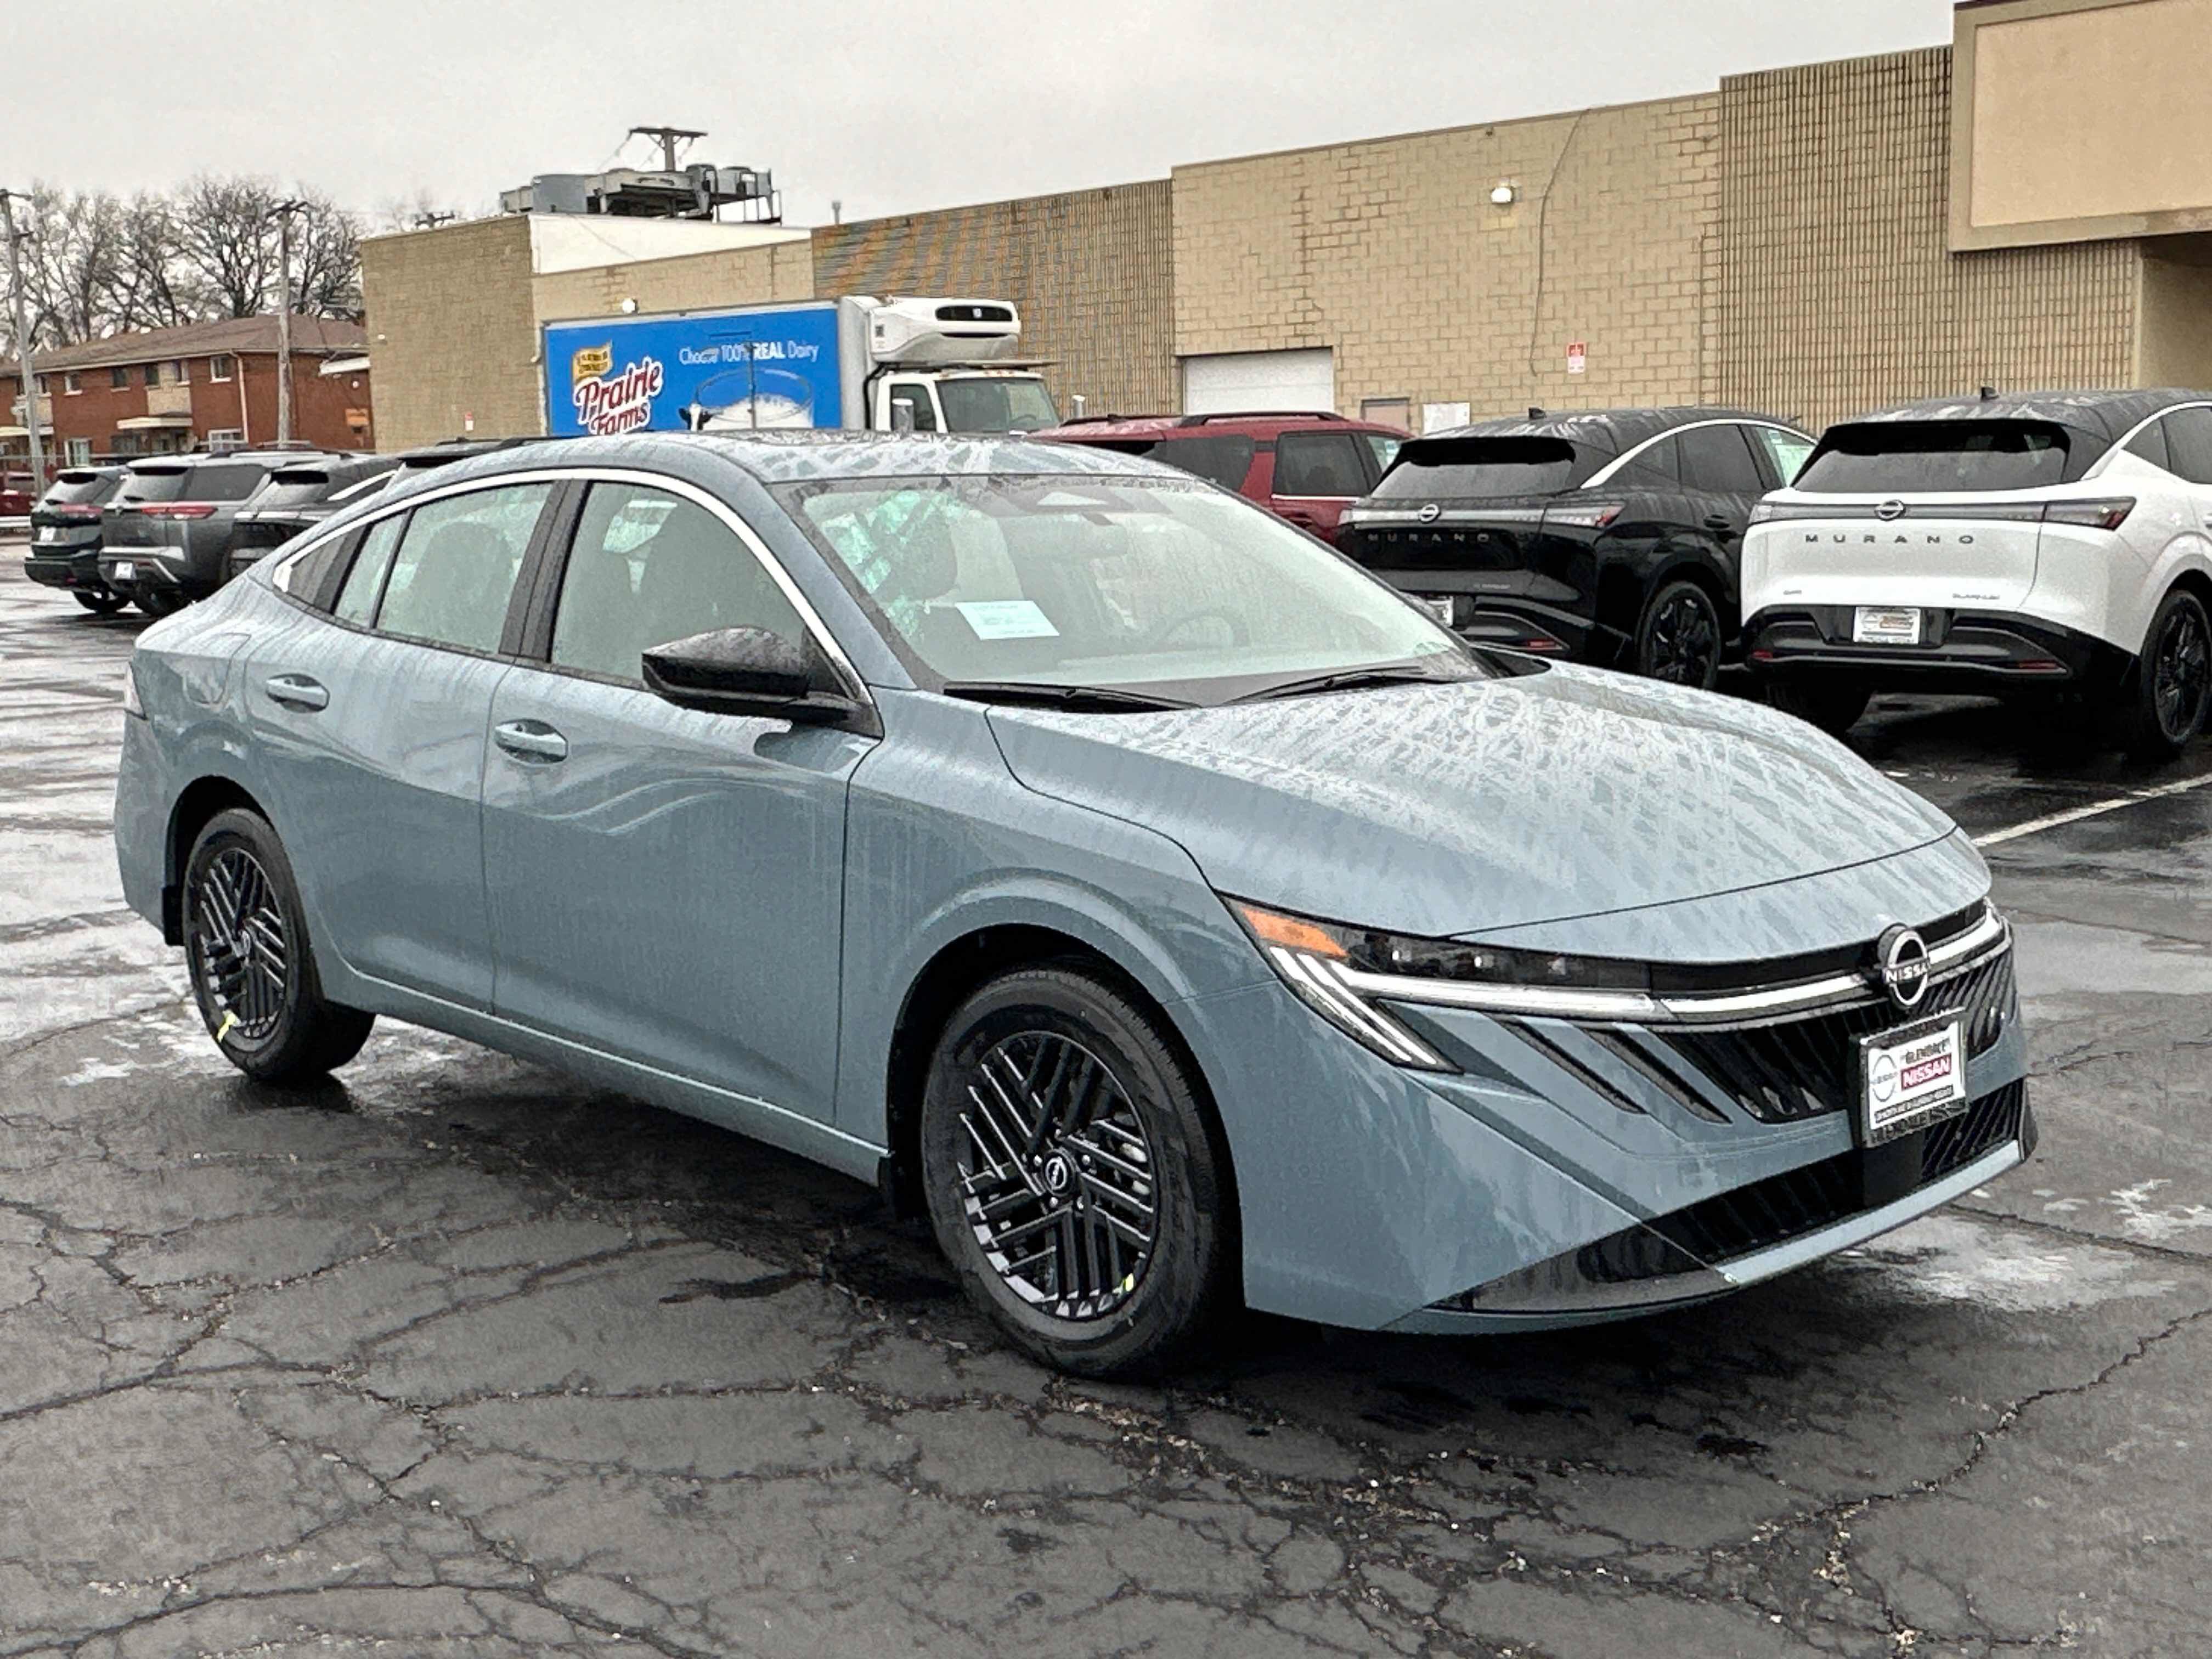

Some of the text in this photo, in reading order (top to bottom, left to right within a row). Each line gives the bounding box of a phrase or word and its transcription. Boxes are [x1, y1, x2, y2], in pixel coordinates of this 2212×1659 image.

[752, 341, 785, 360] REAL
[787, 340, 819, 363] Dairy
[575, 360, 661, 421] Prairie
[590, 403, 648, 436] Farms
[1368, 533, 1489, 543] MURANO
[1805, 534, 1974, 544] MURANO
[1885, 961, 1931, 984] NISSA
[1903, 1055, 1951, 1088] NISSAN
